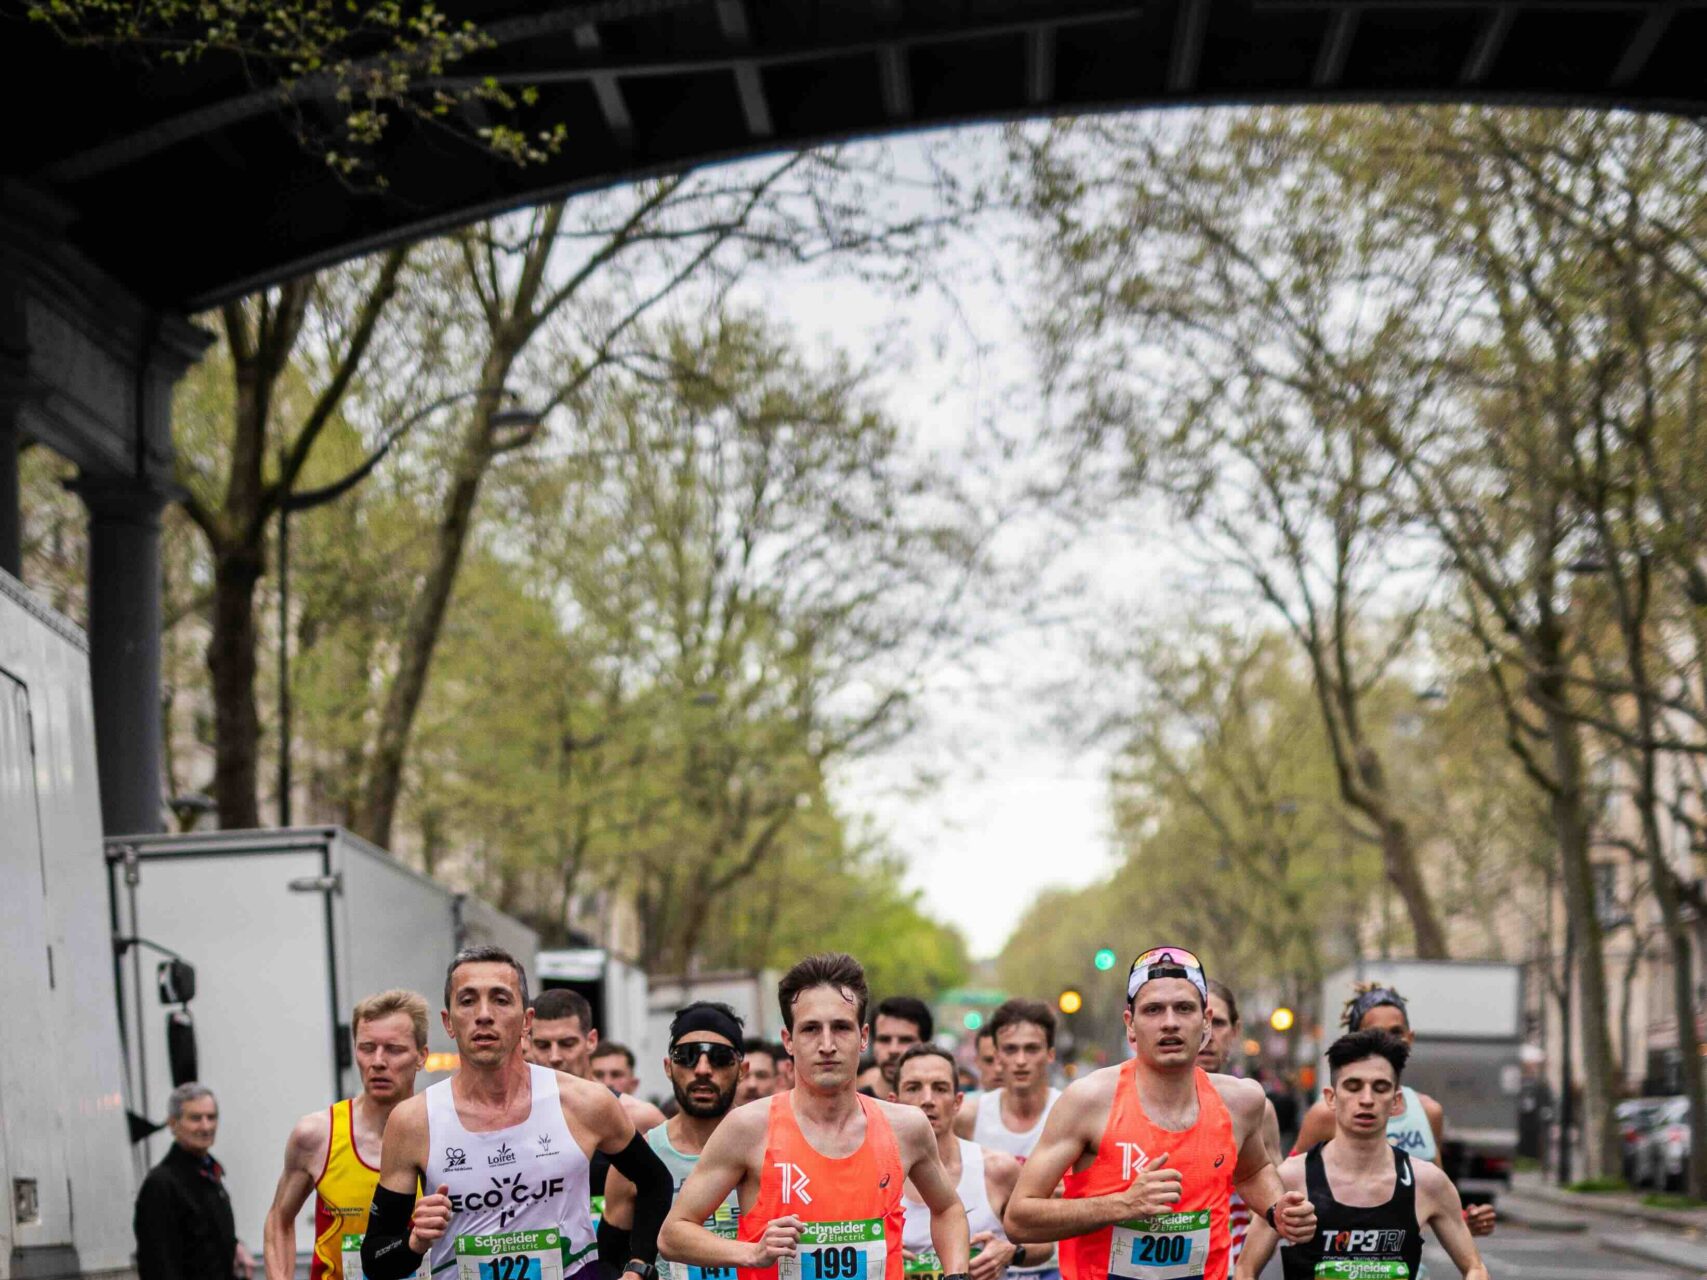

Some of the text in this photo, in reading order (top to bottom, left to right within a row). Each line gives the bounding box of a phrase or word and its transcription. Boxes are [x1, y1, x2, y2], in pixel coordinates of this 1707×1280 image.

[1386, 1131, 1426, 1148] OKA
[487, 1152, 516, 1165] Loiret
[1138, 1213, 1195, 1225] chneider
[802, 1221, 866, 1236] Schneider
[1161, 1224, 1193, 1232] Electric
[474, 1232, 539, 1248] Schneider
[829, 1233, 866, 1242] Electric
[502, 1243, 539, 1252] Electric
[1139, 1235, 1185, 1264] 200
[810, 1246, 858, 1280] 199
[1334, 1261, 1392, 1273] Schneider
[1359, 1271, 1392, 1280] Electric
